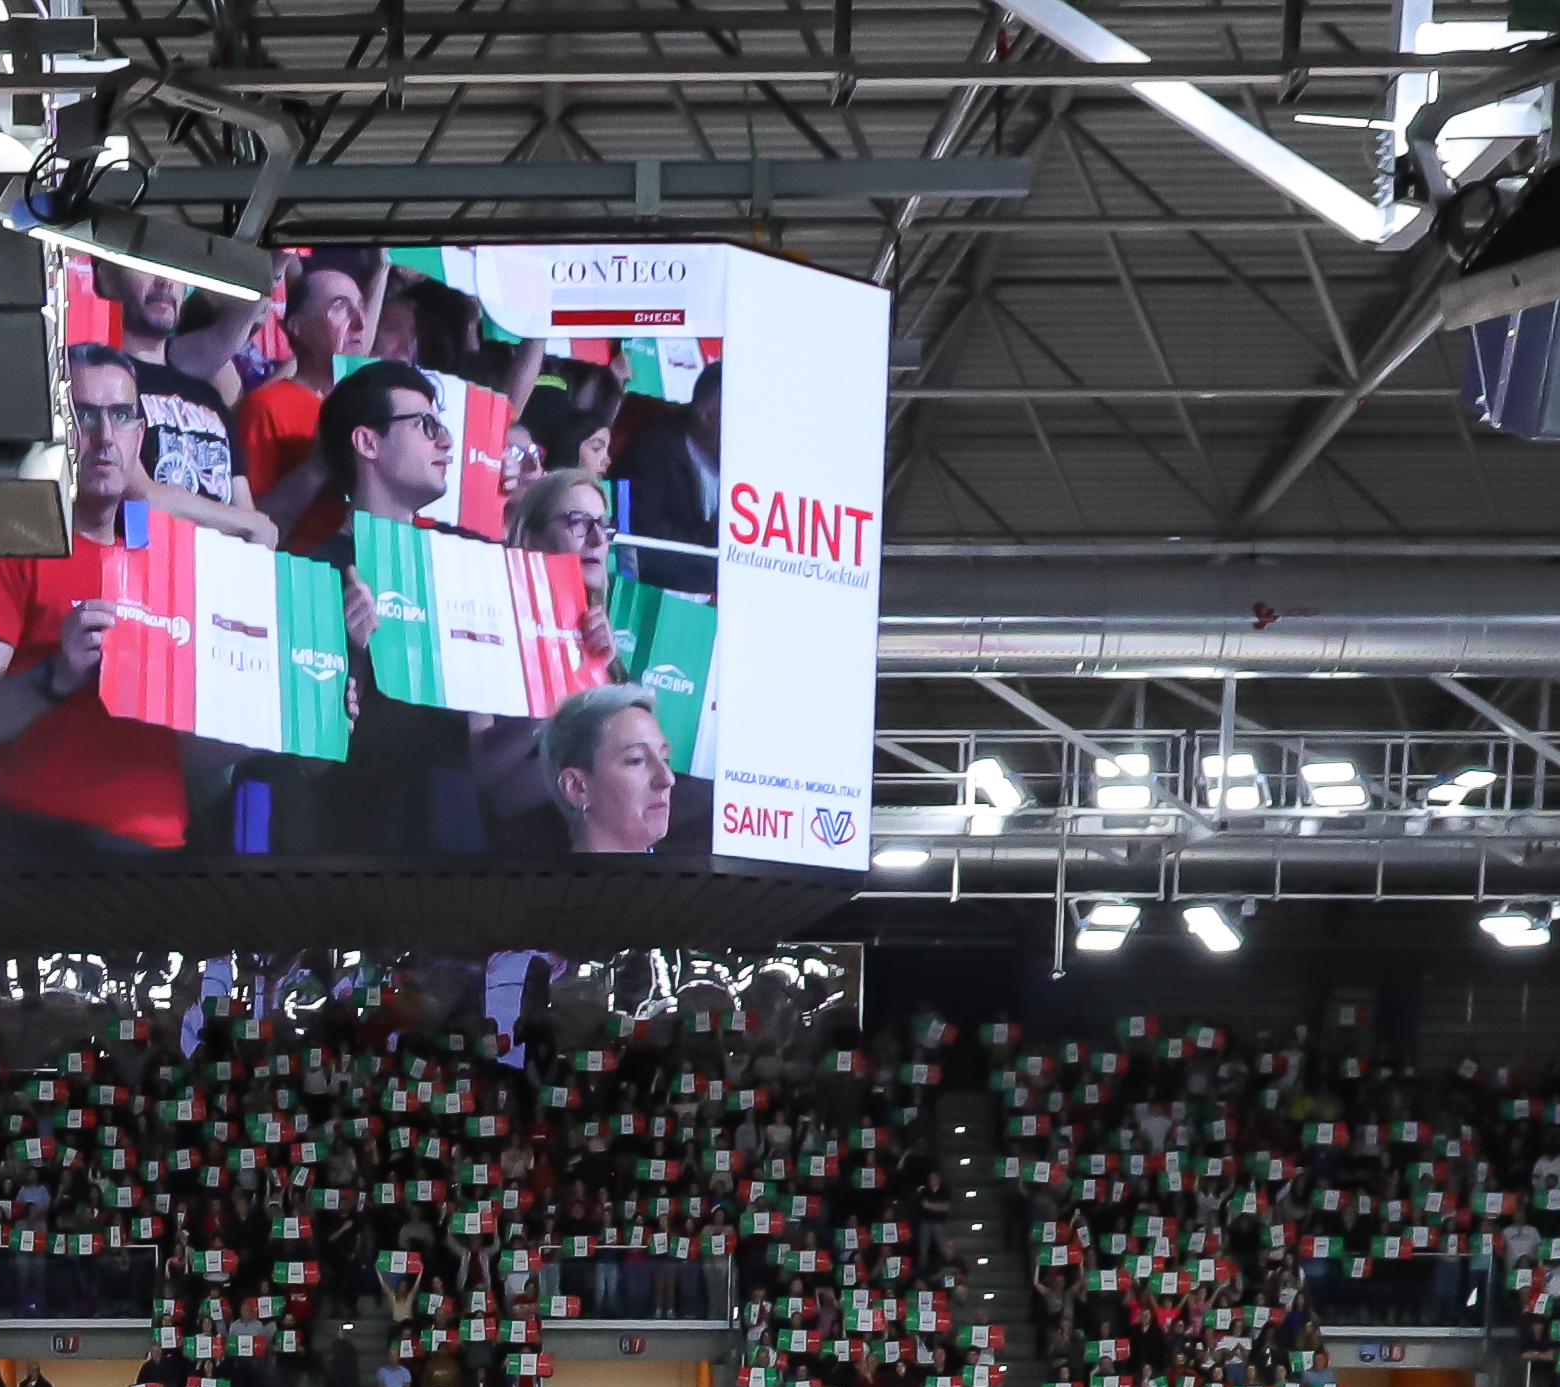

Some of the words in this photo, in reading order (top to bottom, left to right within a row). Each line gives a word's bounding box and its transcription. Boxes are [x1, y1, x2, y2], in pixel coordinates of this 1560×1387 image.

[551, 256, 687, 283] CONTECO
[634, 312, 682, 324] CHECK
[729, 482, 874, 567] SAINT
[723, 803, 794, 840] SAINT
